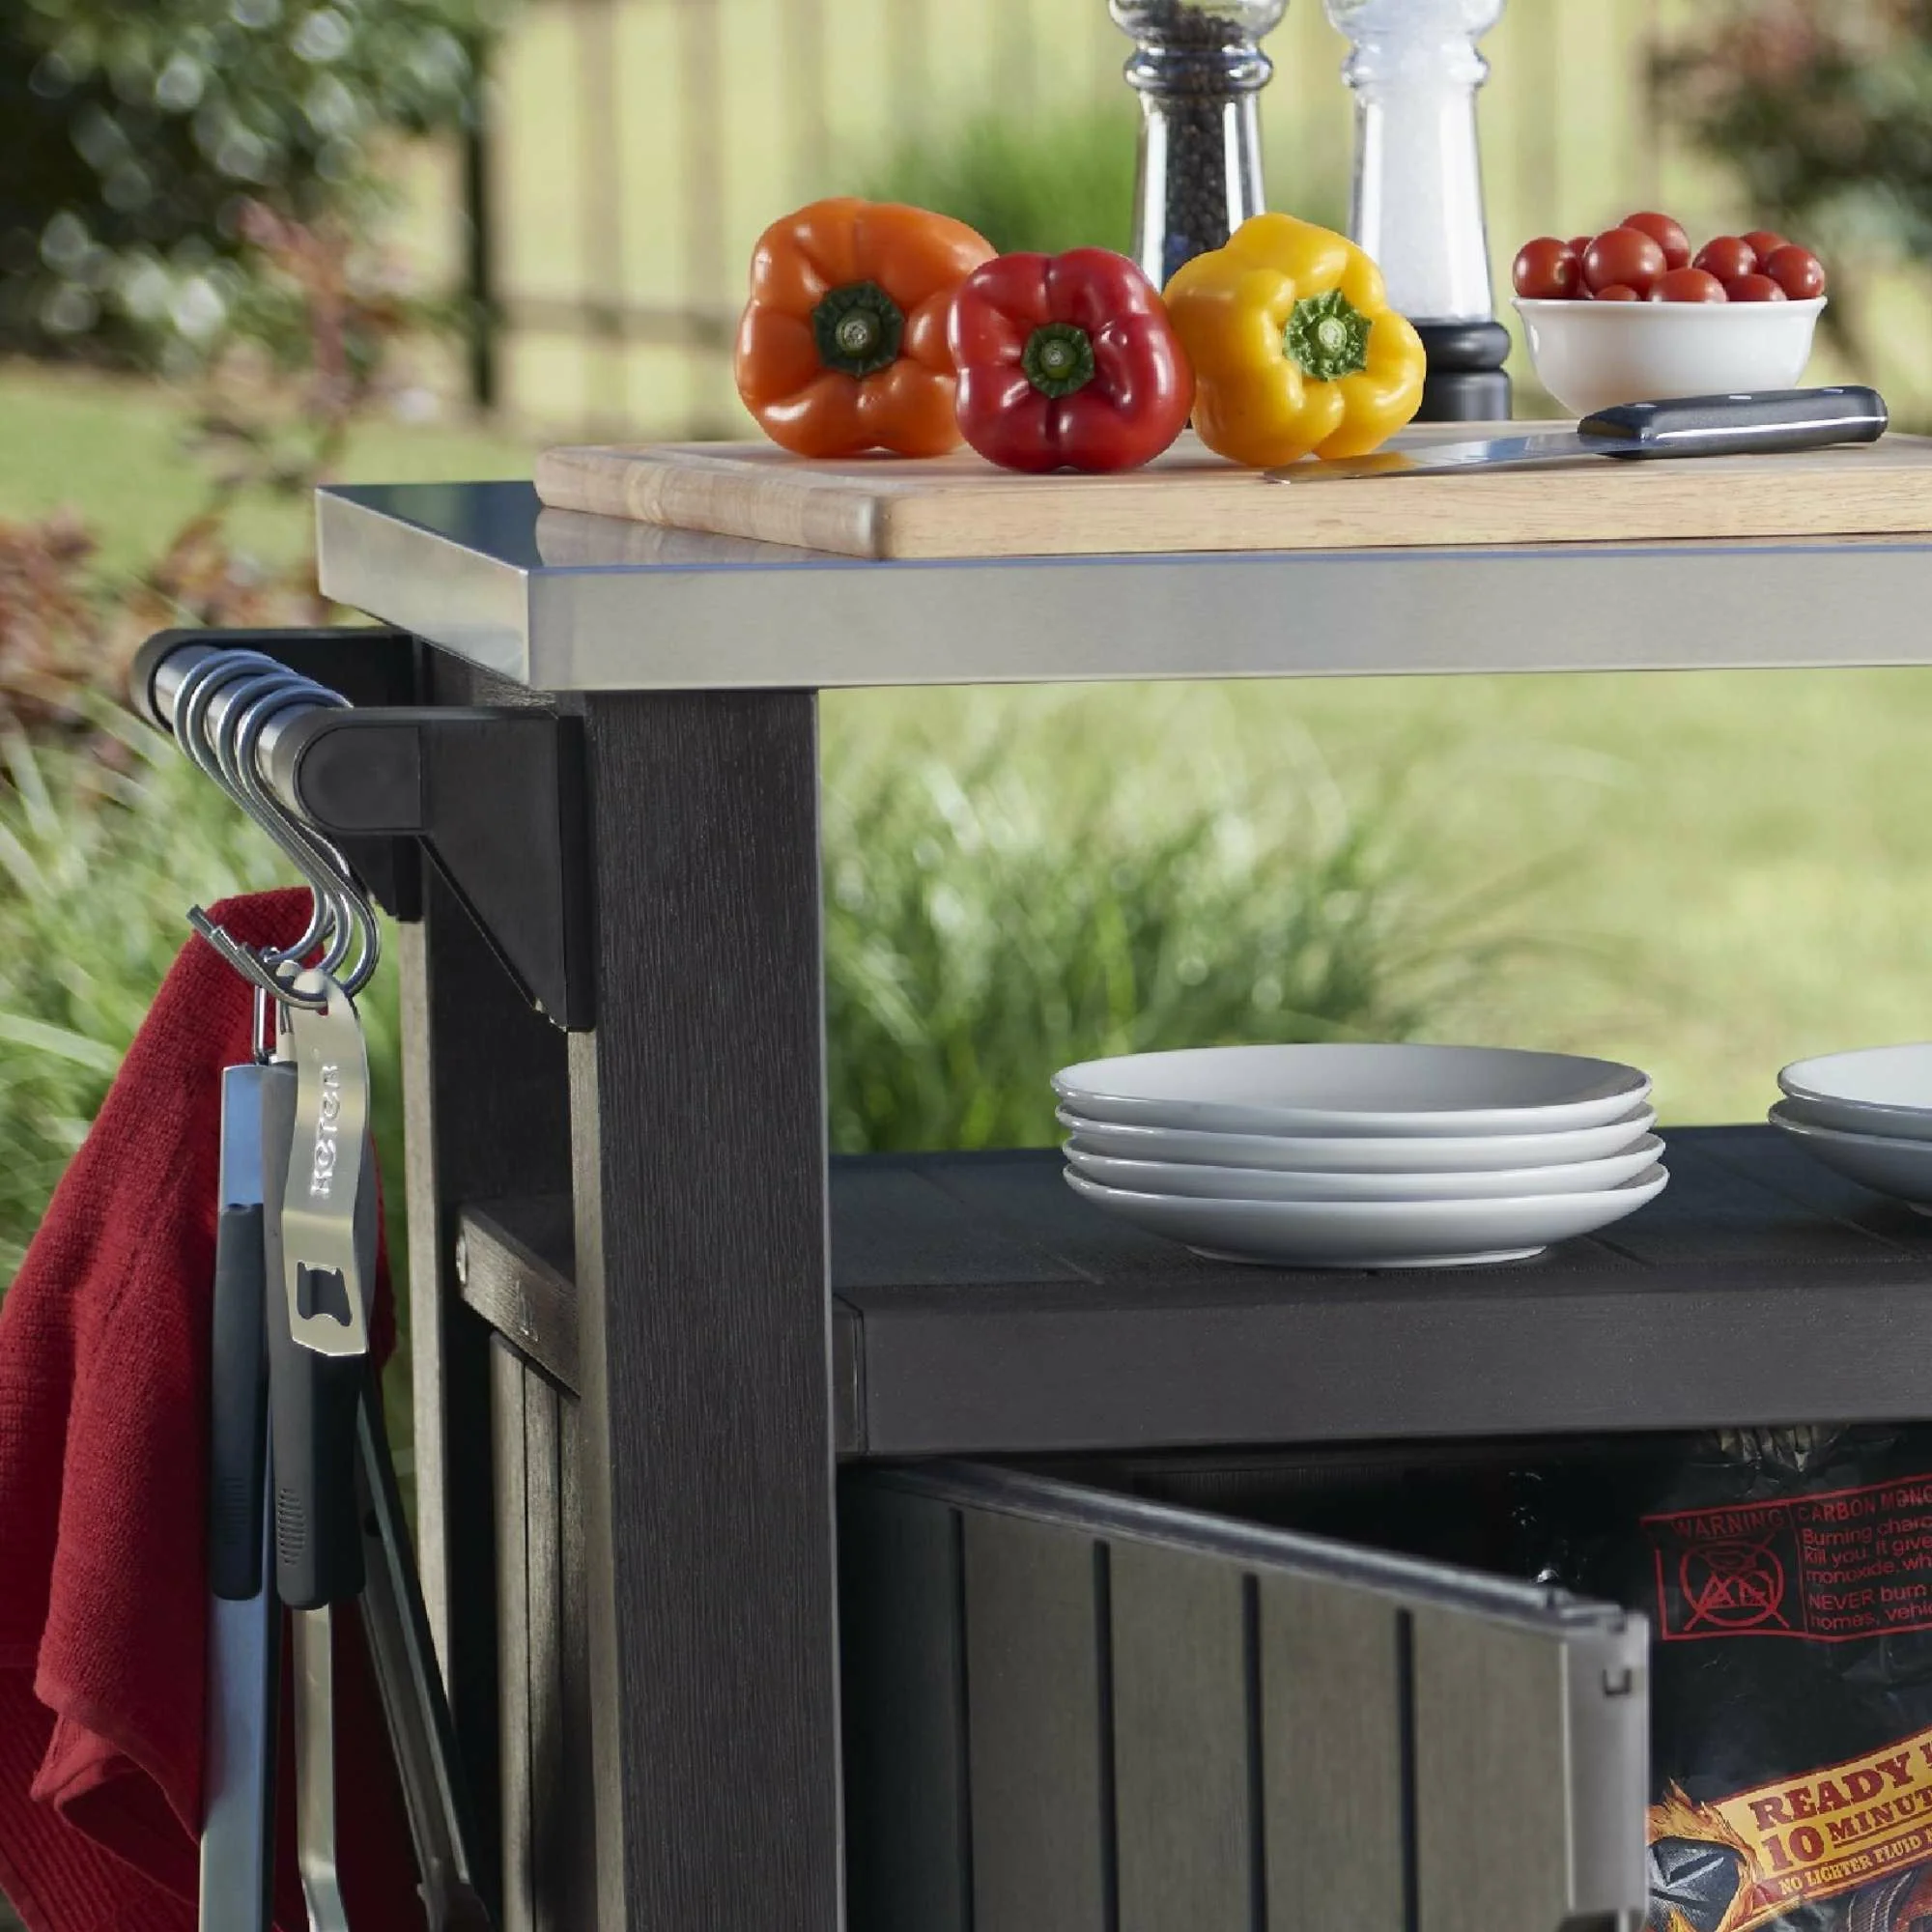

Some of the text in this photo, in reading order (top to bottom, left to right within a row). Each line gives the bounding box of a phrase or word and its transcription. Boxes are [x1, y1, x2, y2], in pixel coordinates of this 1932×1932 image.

[1671, 1509, 1785, 1538] WARNING
[1797, 1496, 1876, 1522] CARBON
[1802, 1525, 1873, 1547] Burning
[1808, 1582, 1926, 1611] NEVER burn
[1748, 1751, 1914, 1832] READY
[1761, 1826, 1825, 1871] 10
[1778, 1876, 1804, 1895] NO
[1804, 1855, 1874, 1887] LIGHTER
[1874, 1834, 1922, 1864] FLUID
